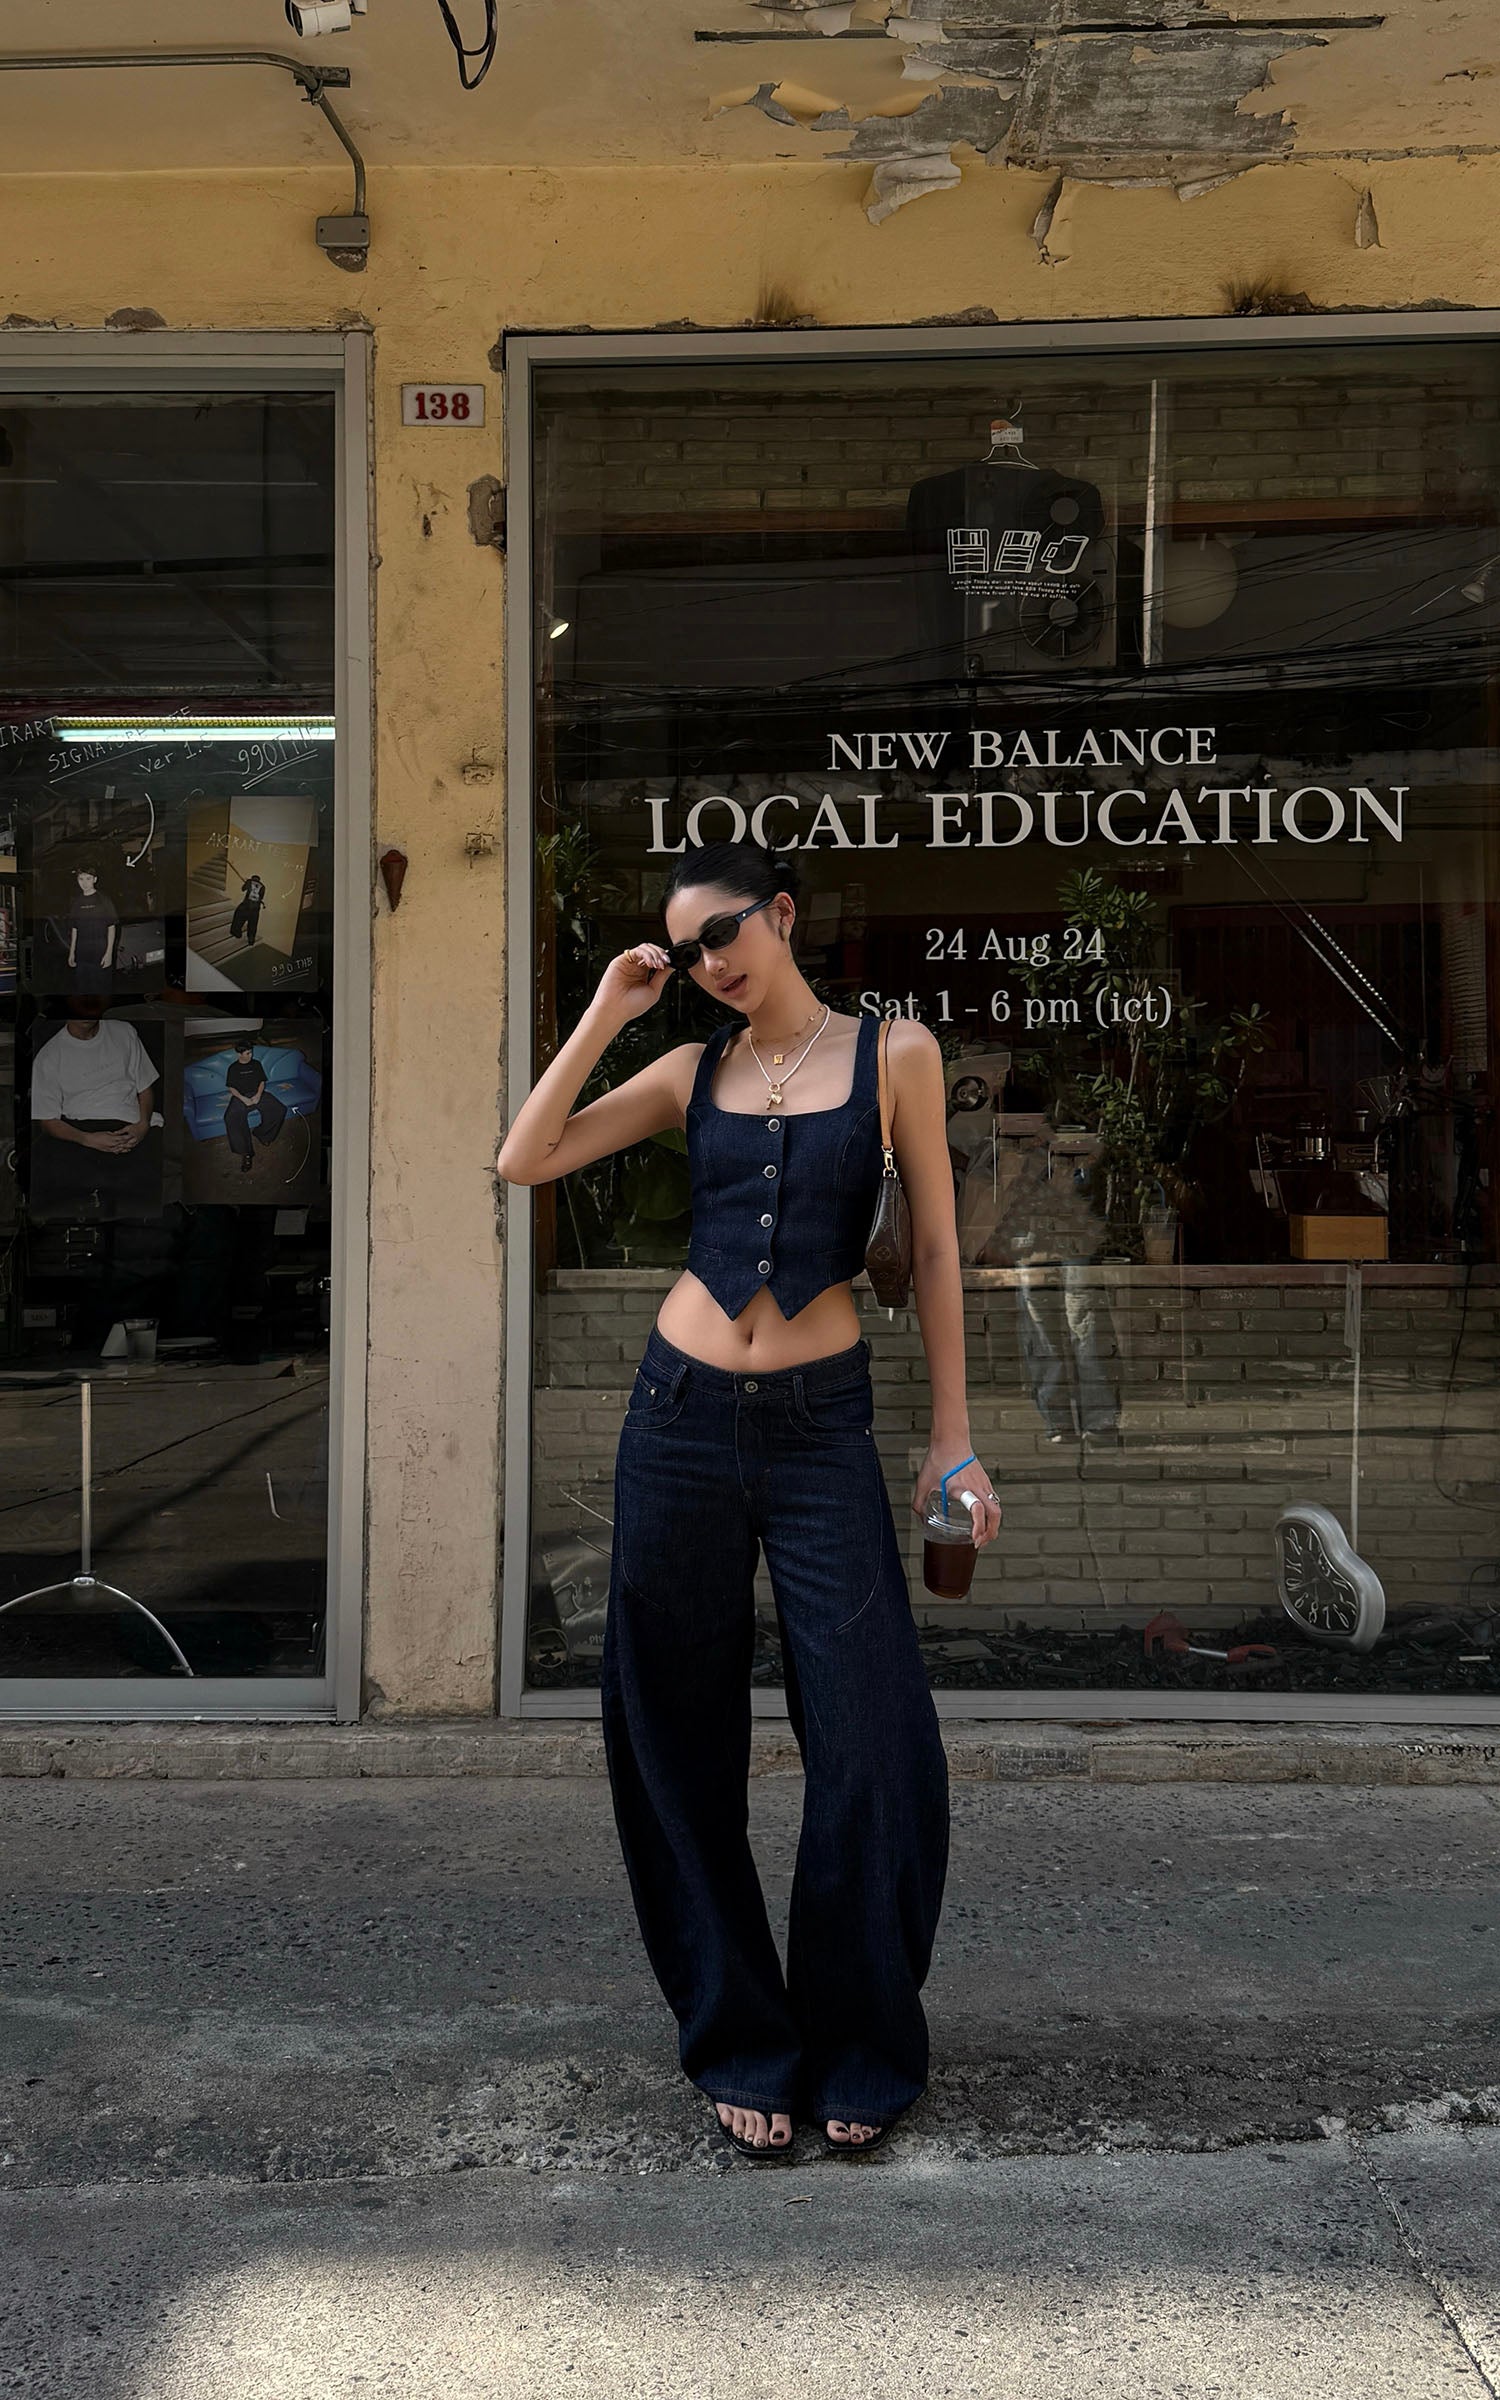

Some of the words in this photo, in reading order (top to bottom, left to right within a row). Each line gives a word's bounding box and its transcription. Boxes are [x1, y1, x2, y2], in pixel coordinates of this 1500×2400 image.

[415, 392, 471, 420] 138
[827, 731, 952, 770] NEW
[969, 727, 1218, 769] BALANCE
[644, 793, 899, 853] LOCAL
[925, 786, 1410, 849] EDUCATION
[926, 928, 967, 960] 24
[978, 928, 1050, 967] Aug
[1063, 928, 1105, 960] 24
[858, 991, 921, 1022] Sat
[936, 990, 955, 1022] 1
[991, 990, 1011, 1022] 6
[1024, 998, 1082, 1029] pm
[1095, 986, 1173, 1029] (ict)
